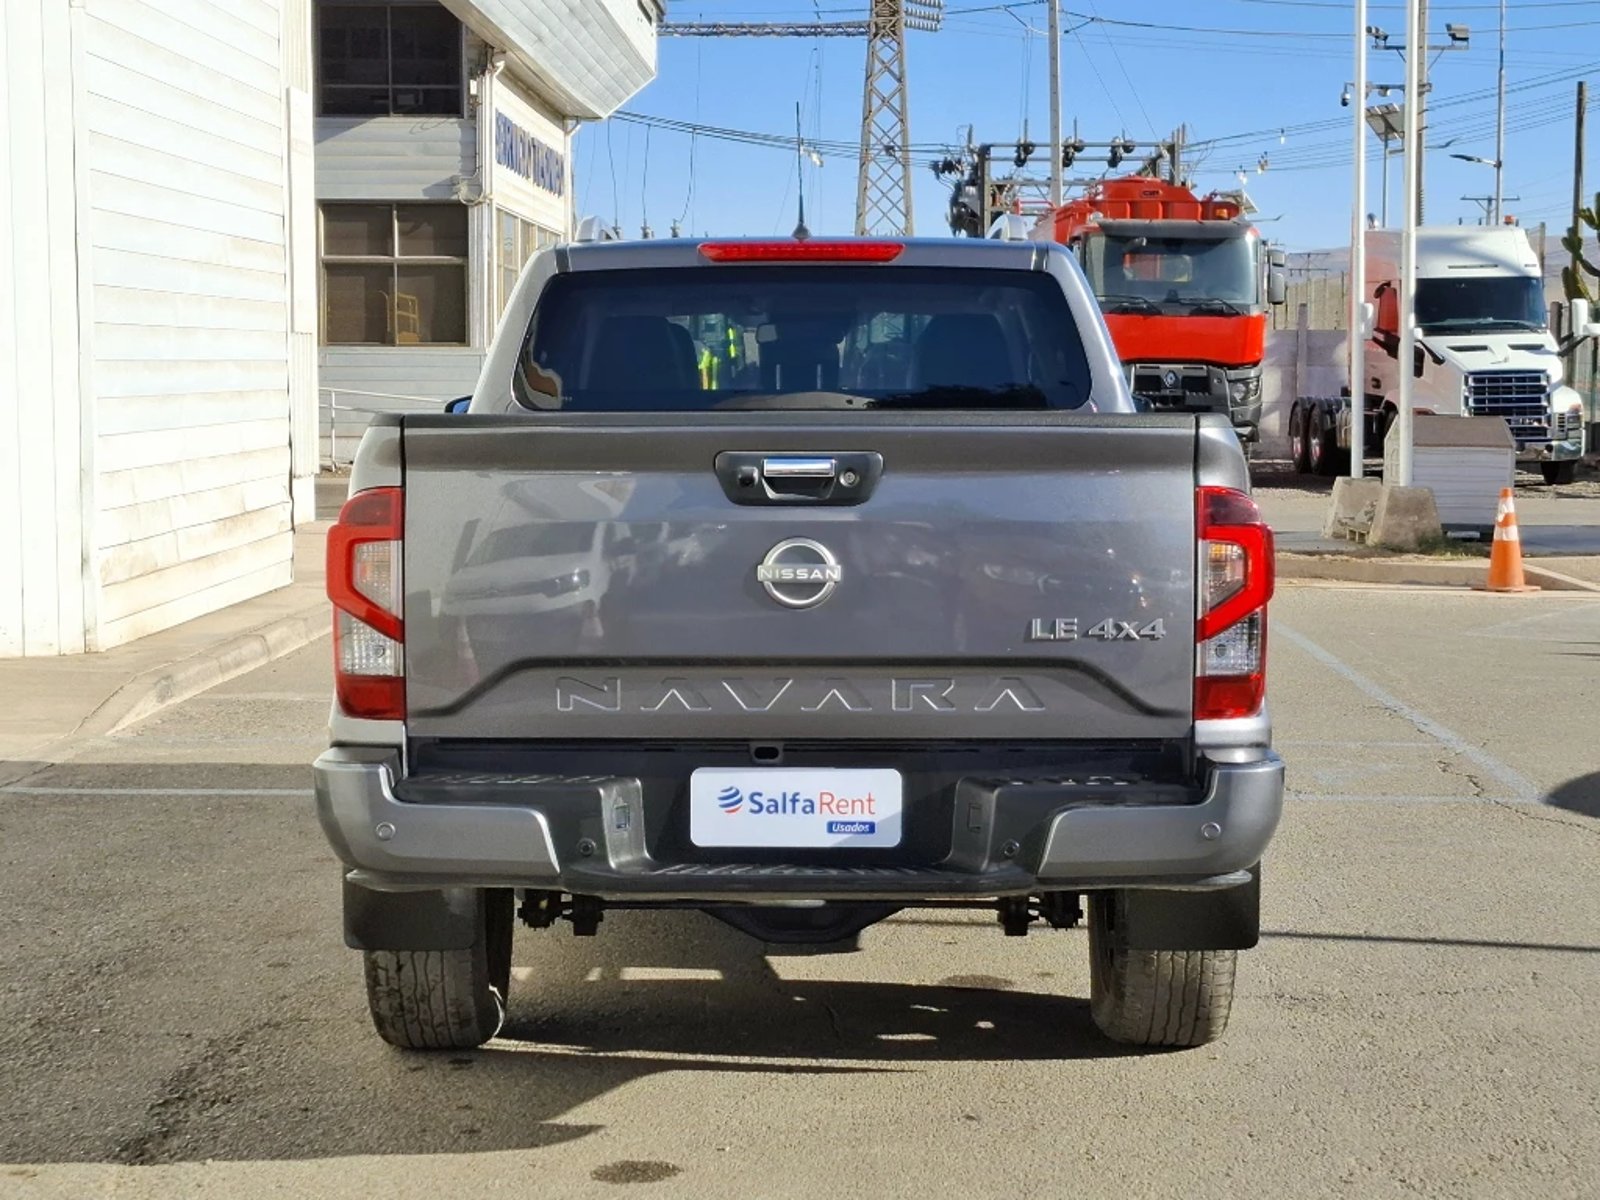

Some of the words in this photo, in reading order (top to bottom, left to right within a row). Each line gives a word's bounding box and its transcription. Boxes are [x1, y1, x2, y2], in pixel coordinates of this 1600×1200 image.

[760, 568, 839, 580] NISSAN
[1031, 617, 1078, 640] LE
[555, 676, 1046, 711] NAVARA
[832, 822, 870, 833] Usados
